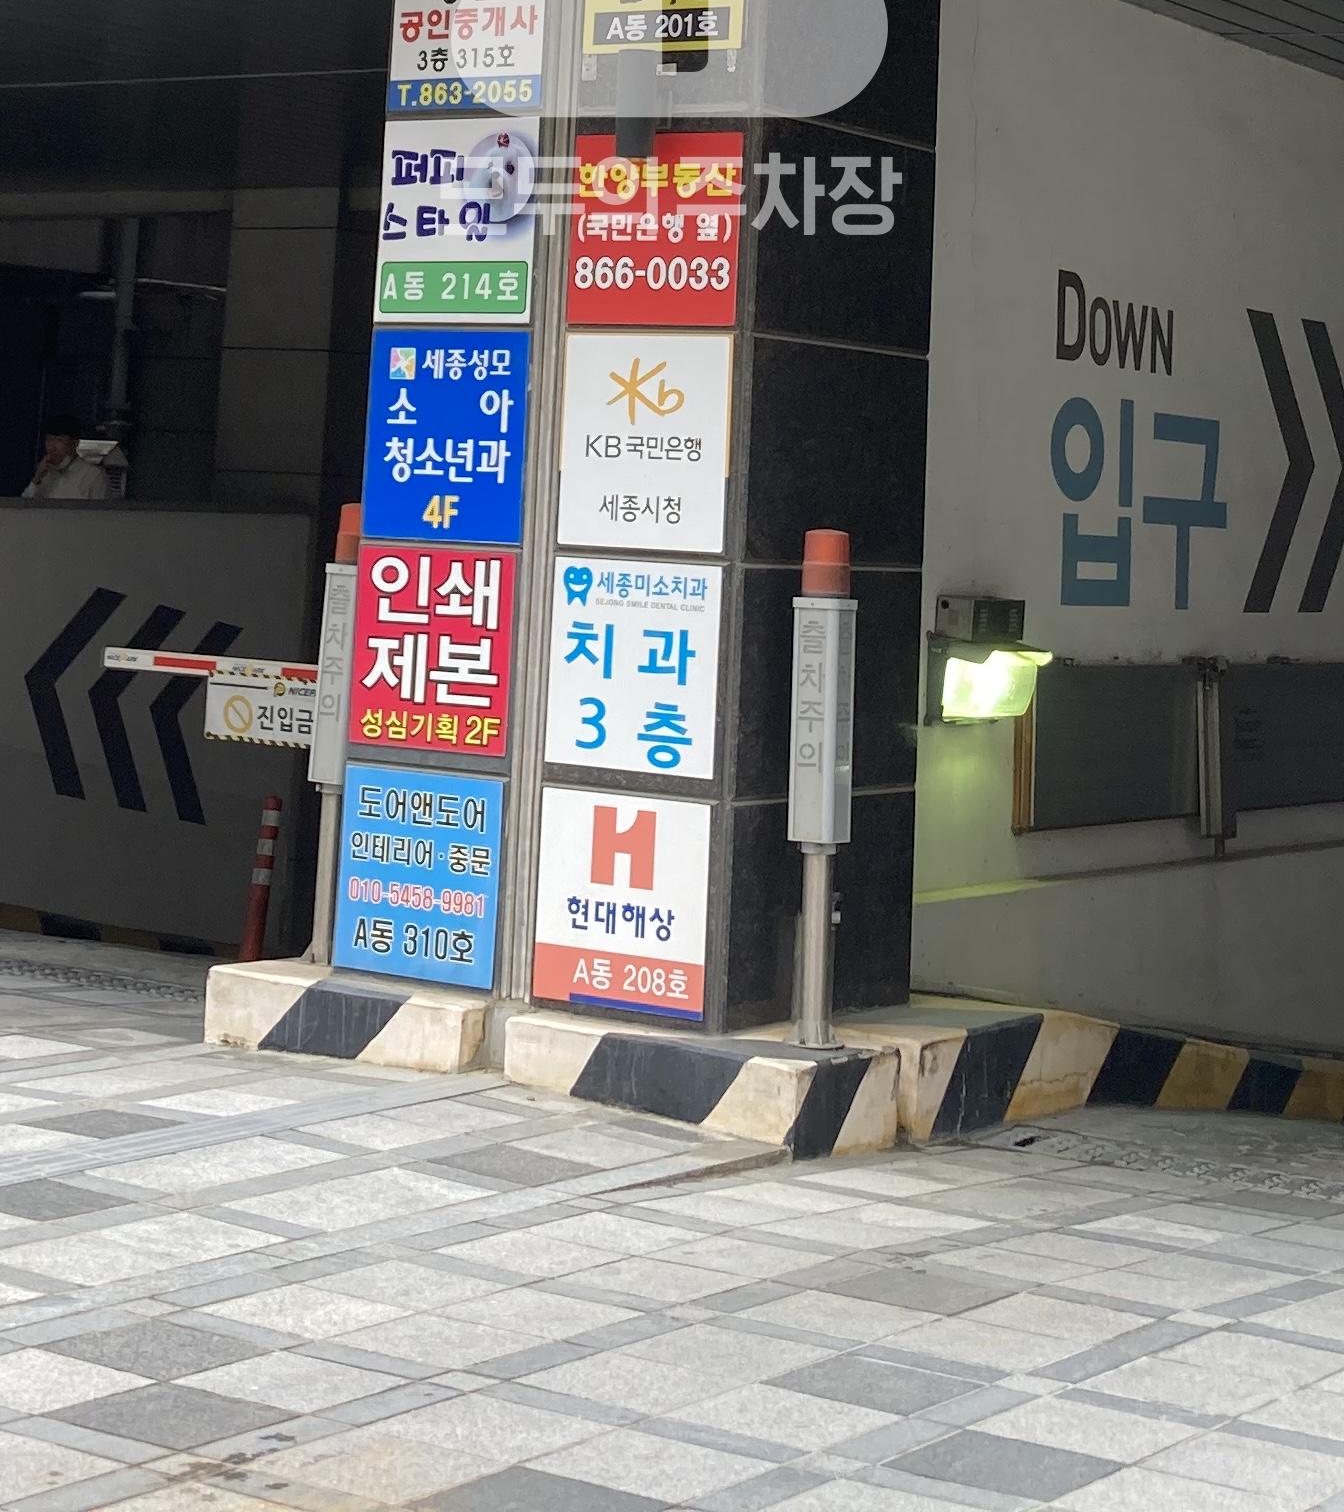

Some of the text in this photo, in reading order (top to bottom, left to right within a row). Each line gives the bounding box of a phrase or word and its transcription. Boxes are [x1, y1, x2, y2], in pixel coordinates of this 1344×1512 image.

[400, 5, 538, 43] 공인중개사
[606, 11, 719, 41] A동 201호
[417, 44, 515, 72] 3층 315호
[397, 79, 533, 107] T.863-2055
[391, 148, 465, 187] 퍼피
[579, 161, 737, 201] 한양부동산
[382, 200, 491, 243] 스타일
[577, 211, 732, 245] (국민은행 옆)
[382, 269, 520, 301] A동 214호
[574, 255, 731, 291] 866-0033
[422, 348, 512, 381] 세종성모
[383, 437, 511, 484] 청소년과
[422, 494, 460, 530] 4F
[598, 494, 682, 525] 세종시청
[1050, 396, 1228, 610] 입구
[370, 554, 501, 631] 인쇄
[597, 571, 708, 601] 세종미소치과
[626, 600, 649, 609] SMILE
[651, 602, 678, 611] DENTAL
[680, 603, 705, 612] CLINIC
[360, 632, 500, 708] 제본
[257, 705, 314, 735] 진입금
[360, 710, 501, 746] 성심기획 2F
[358, 785, 487, 834] 도어앤도어
[348, 877, 485, 918] 010-5458-9981
[567, 896, 676, 943] 현대해상
[354, 917, 474, 965] A동 310호
[573, 959, 689, 1001] A동 208호
